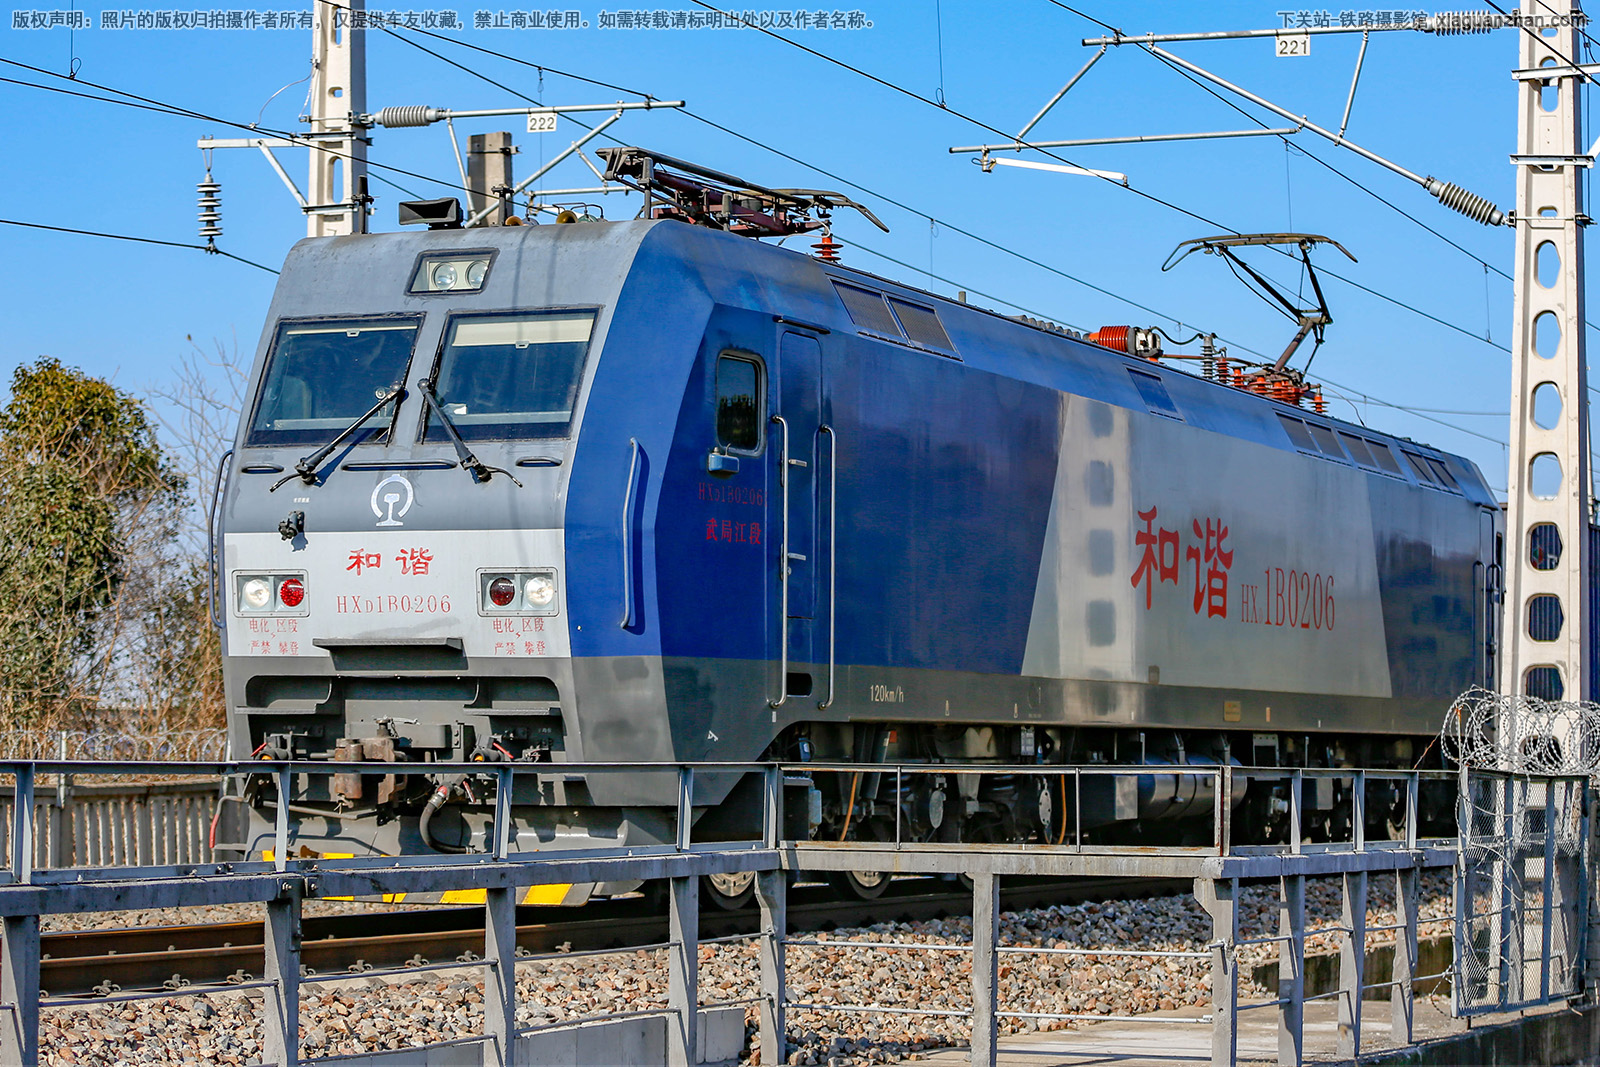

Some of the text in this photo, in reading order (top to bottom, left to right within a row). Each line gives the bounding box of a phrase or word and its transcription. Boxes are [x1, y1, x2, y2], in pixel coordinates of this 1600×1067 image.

[1279, 40, 1307, 54] 221
[529, 116, 555, 130] 222
[706, 517, 762, 545] 武局江段
[346, 548, 434, 576] 和谐
[1131, 505, 1234, 619] 和谐
[870, 684, 905, 703] 120km/h
